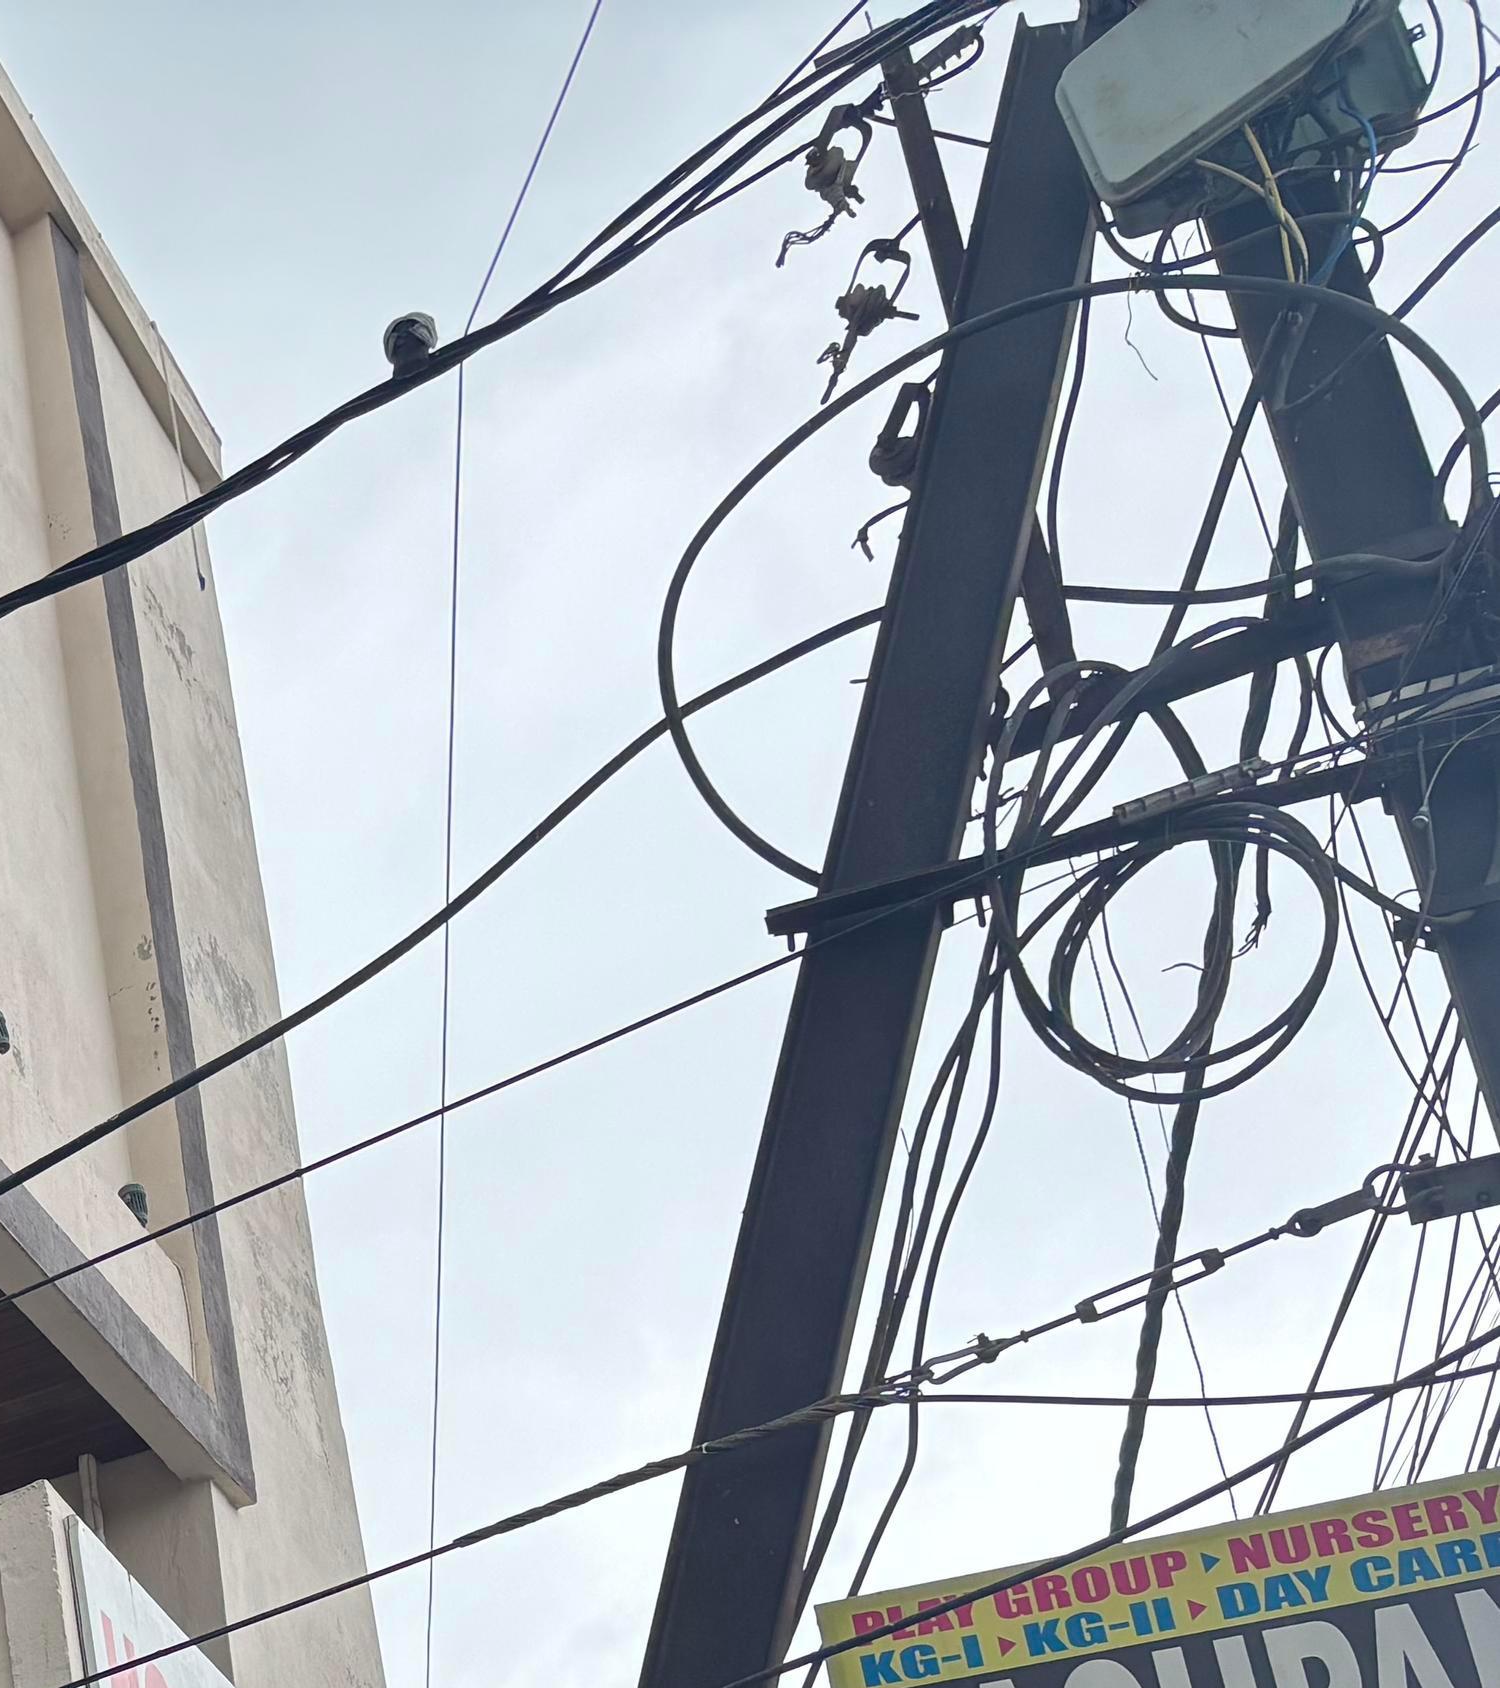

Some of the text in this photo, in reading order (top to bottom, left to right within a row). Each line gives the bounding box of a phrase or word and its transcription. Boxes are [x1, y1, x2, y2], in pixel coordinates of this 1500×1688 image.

[852, 1485, 1500, 1646] PLAY GROUP NURSERY
[860, 1634, 985, 1688] KG-I
[1023, 1597, 1176, 1657] KG-II
[1216, 1565, 1331, 1620] DAY
